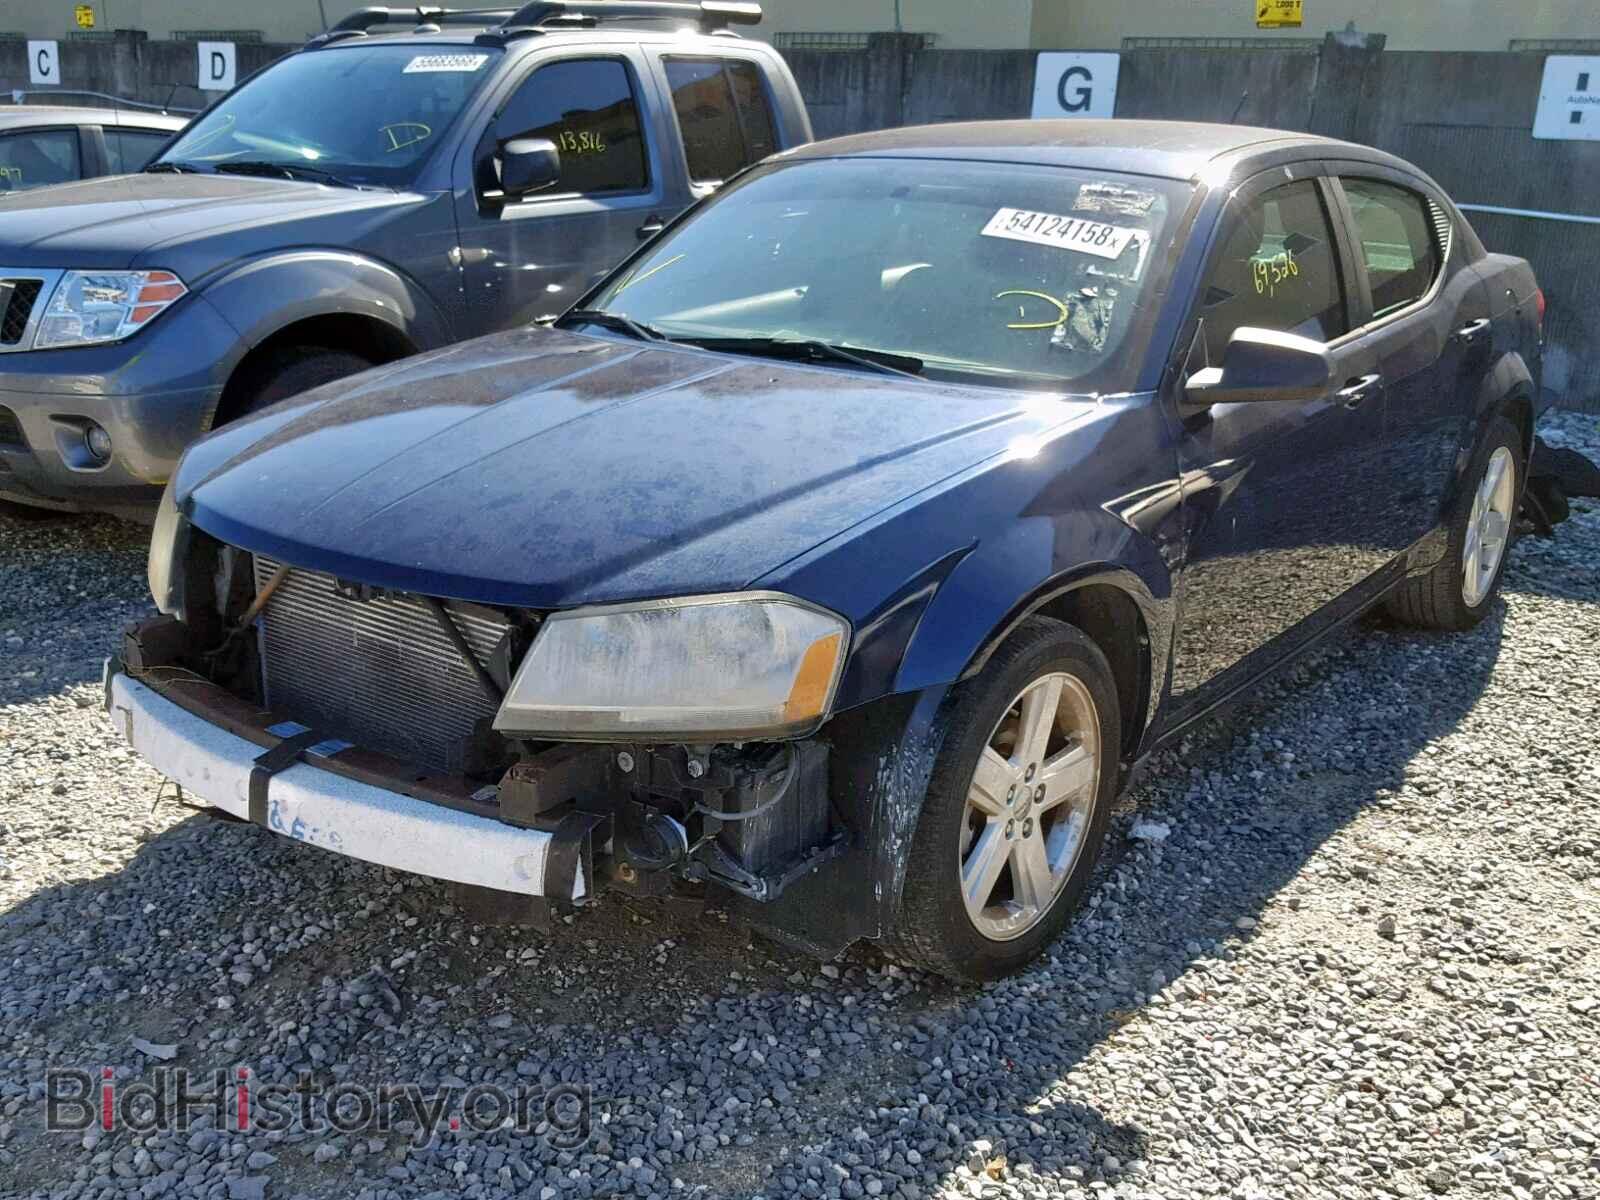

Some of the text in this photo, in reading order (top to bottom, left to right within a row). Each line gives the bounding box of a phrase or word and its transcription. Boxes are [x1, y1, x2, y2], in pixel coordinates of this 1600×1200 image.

[37, 49, 50, 76] C
[211, 51, 226, 80] D
[1057, 66, 1093, 113] G
[559, 131, 606, 153] 13,816
